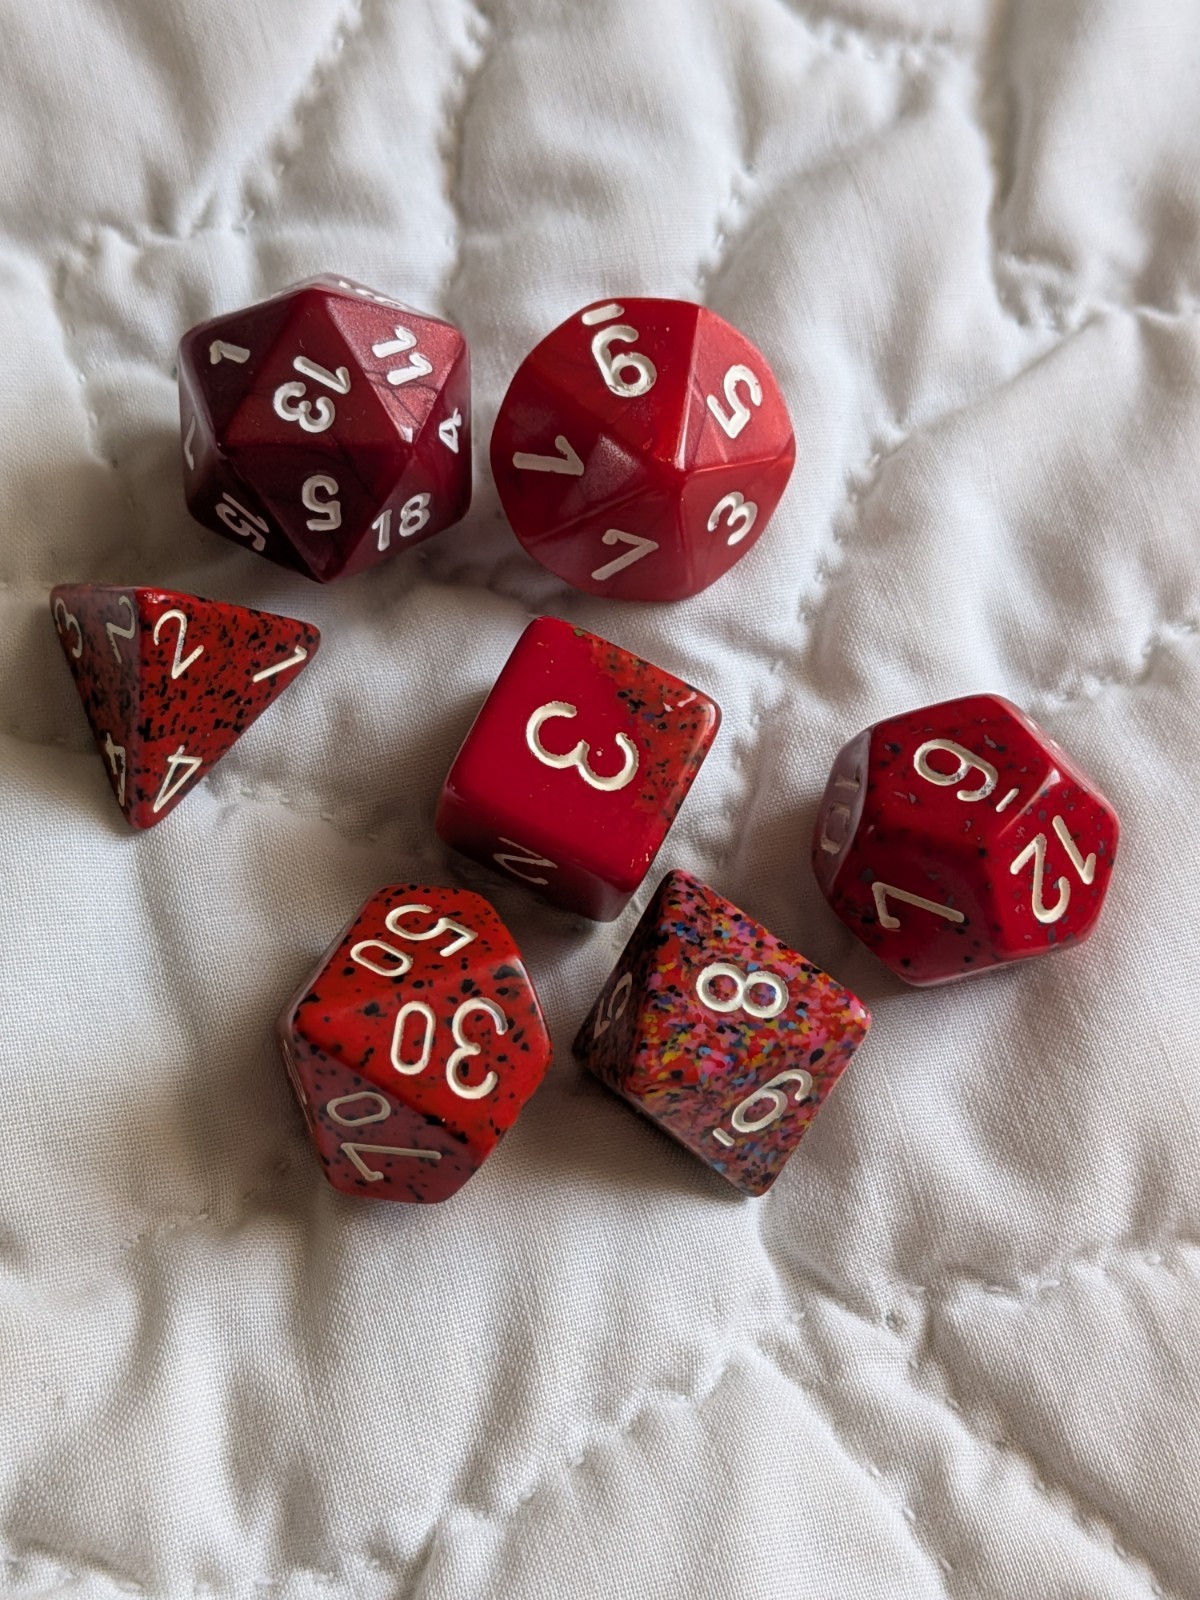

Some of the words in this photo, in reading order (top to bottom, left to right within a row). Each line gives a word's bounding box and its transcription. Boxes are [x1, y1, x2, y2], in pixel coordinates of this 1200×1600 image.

[208, 339, 250, 364] 1
[371, 325, 433, 385] 11
[273, 355, 351, 433] 13
[707, 364, 763, 439] 5
[438, 407, 463, 454] 4
[512, 434, 585, 476] 1
[215, 492, 270, 551] 15
[301, 474, 342, 531] 5
[371, 493, 431, 551] 18
[707, 491, 758, 546] 3
[591, 528, 659, 581] 7
[54, 597, 83, 659] 3
[106, 595, 136, 664] 2
[153, 609, 204, 680] 2
[253, 644, 308, 683] 1
[526, 700, 640, 792] 3
[152, 744, 203, 813] 4
[493, 836, 559, 886] 2
[1010, 814, 1097, 922] 12
[871, 881, 965, 930] 7
[350, 904, 478, 977] 50
[695, 962, 789, 1019] 8
[390, 997, 508, 1100] 30
[326, 1091, 442, 1182] 70
